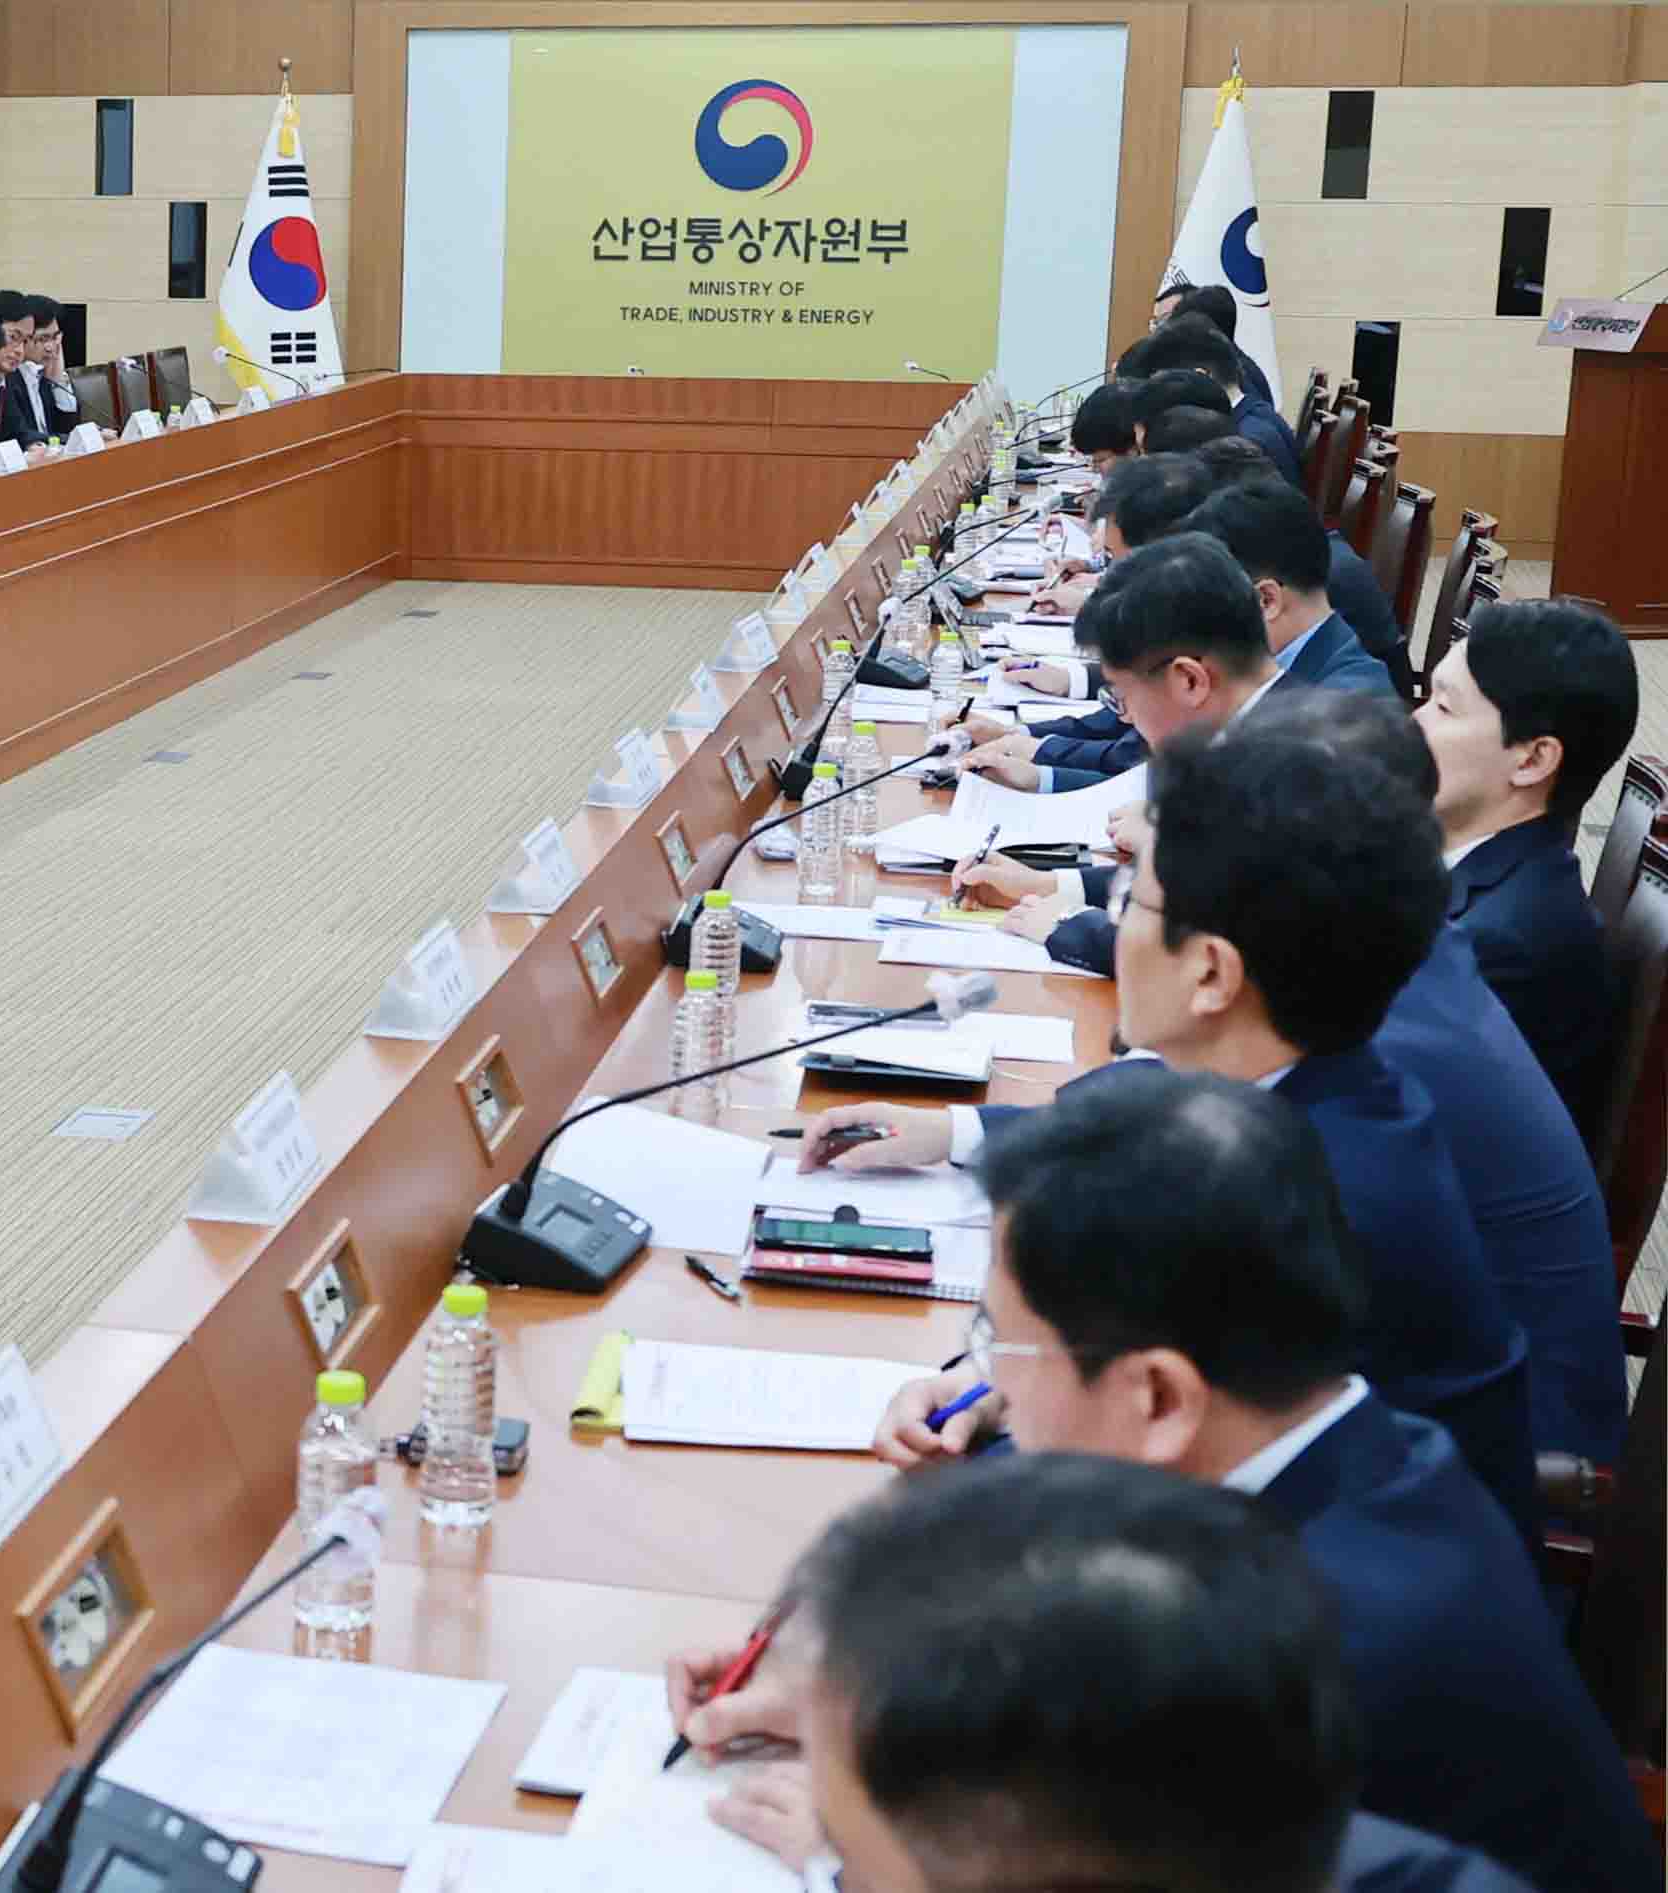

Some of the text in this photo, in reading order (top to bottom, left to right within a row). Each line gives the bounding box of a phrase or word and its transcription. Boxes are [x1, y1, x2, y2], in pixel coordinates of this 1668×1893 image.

[592, 216, 909, 264] 산업통상자원부
[688, 281, 805, 297] MINISTRY OF
[620, 306, 874, 325] TRADE, INDUSTRY & ENERGY
